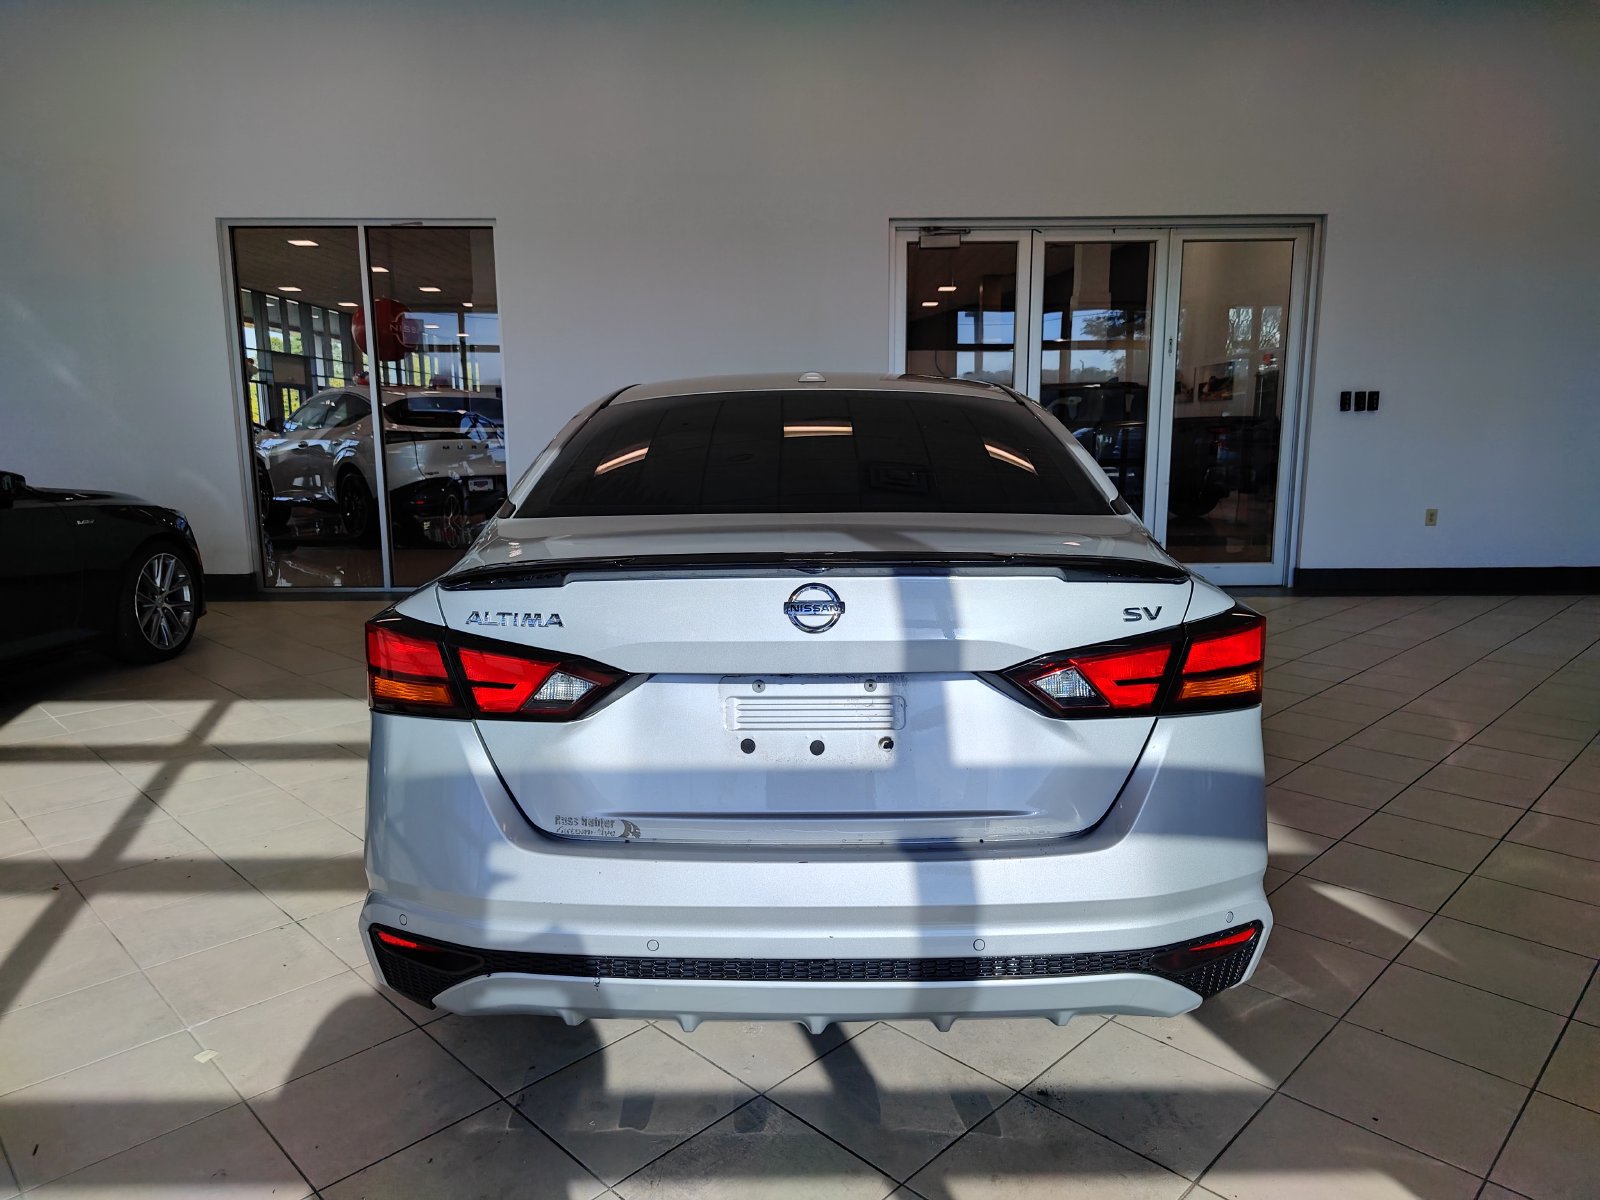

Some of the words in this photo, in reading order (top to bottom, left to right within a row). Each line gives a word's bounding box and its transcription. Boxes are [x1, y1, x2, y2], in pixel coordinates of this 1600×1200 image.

[790, 604, 839, 612] NISSAN
[1123, 606, 1162, 622] SV
[465, 611, 564, 628] ALTIMA
